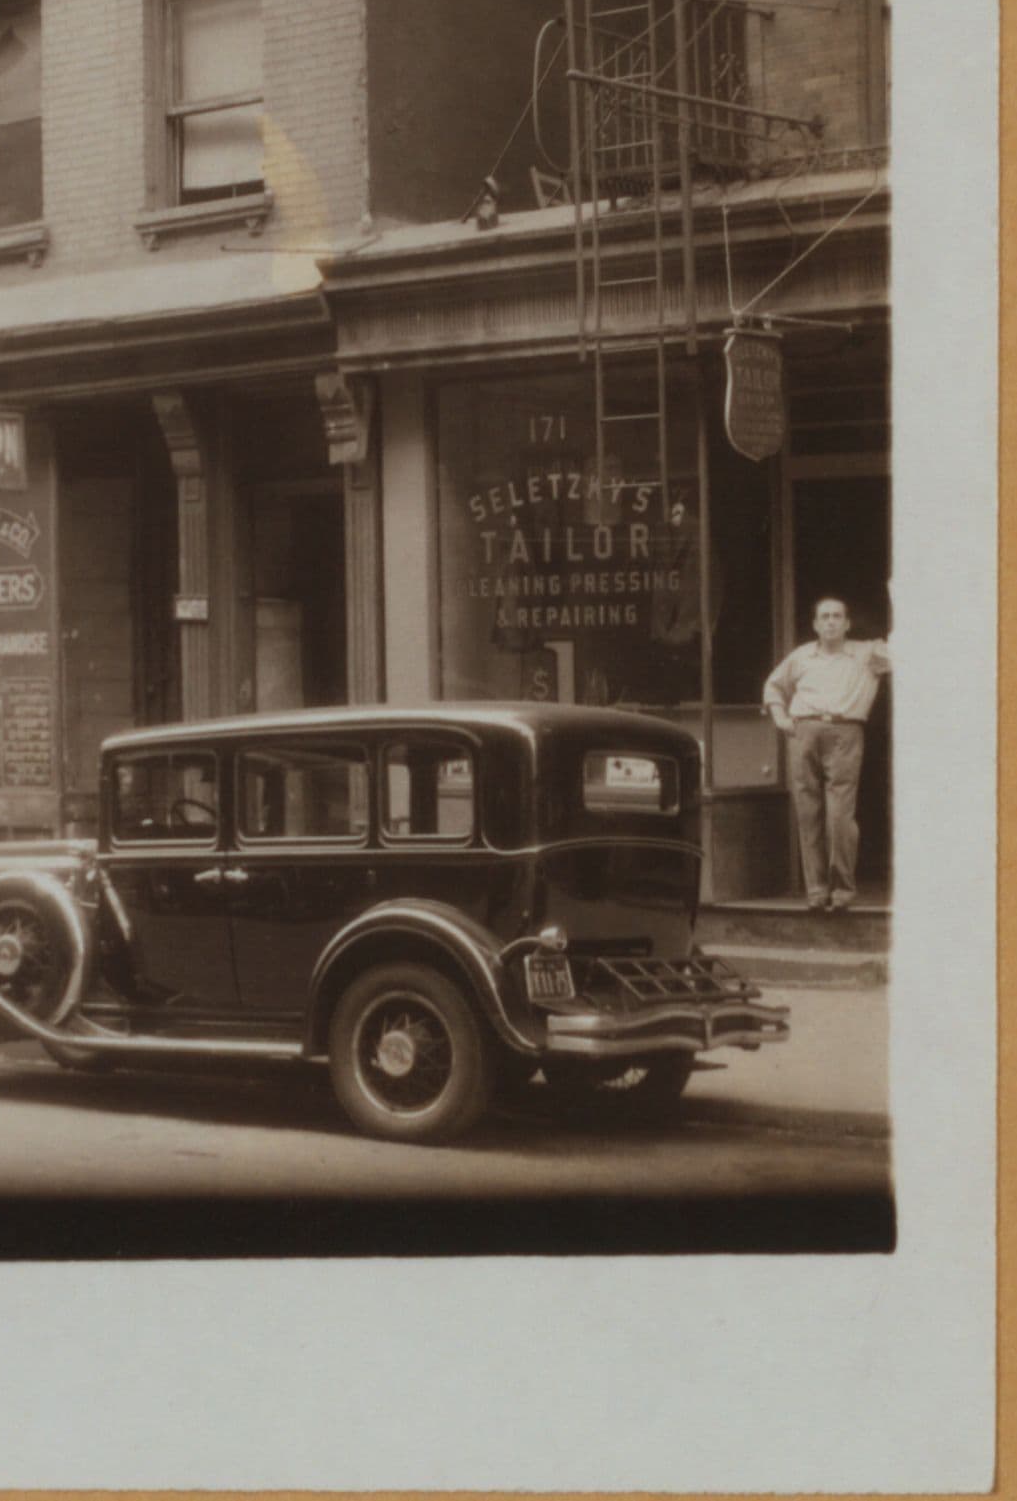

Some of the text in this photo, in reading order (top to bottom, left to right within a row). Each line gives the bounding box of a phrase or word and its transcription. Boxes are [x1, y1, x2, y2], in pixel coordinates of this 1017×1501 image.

[528, 414, 568, 443] 171
[480, 522, 650, 564] TAILOR
[569, 570, 681, 595] PRESSING
[517, 604, 639, 629] REPAIRING
